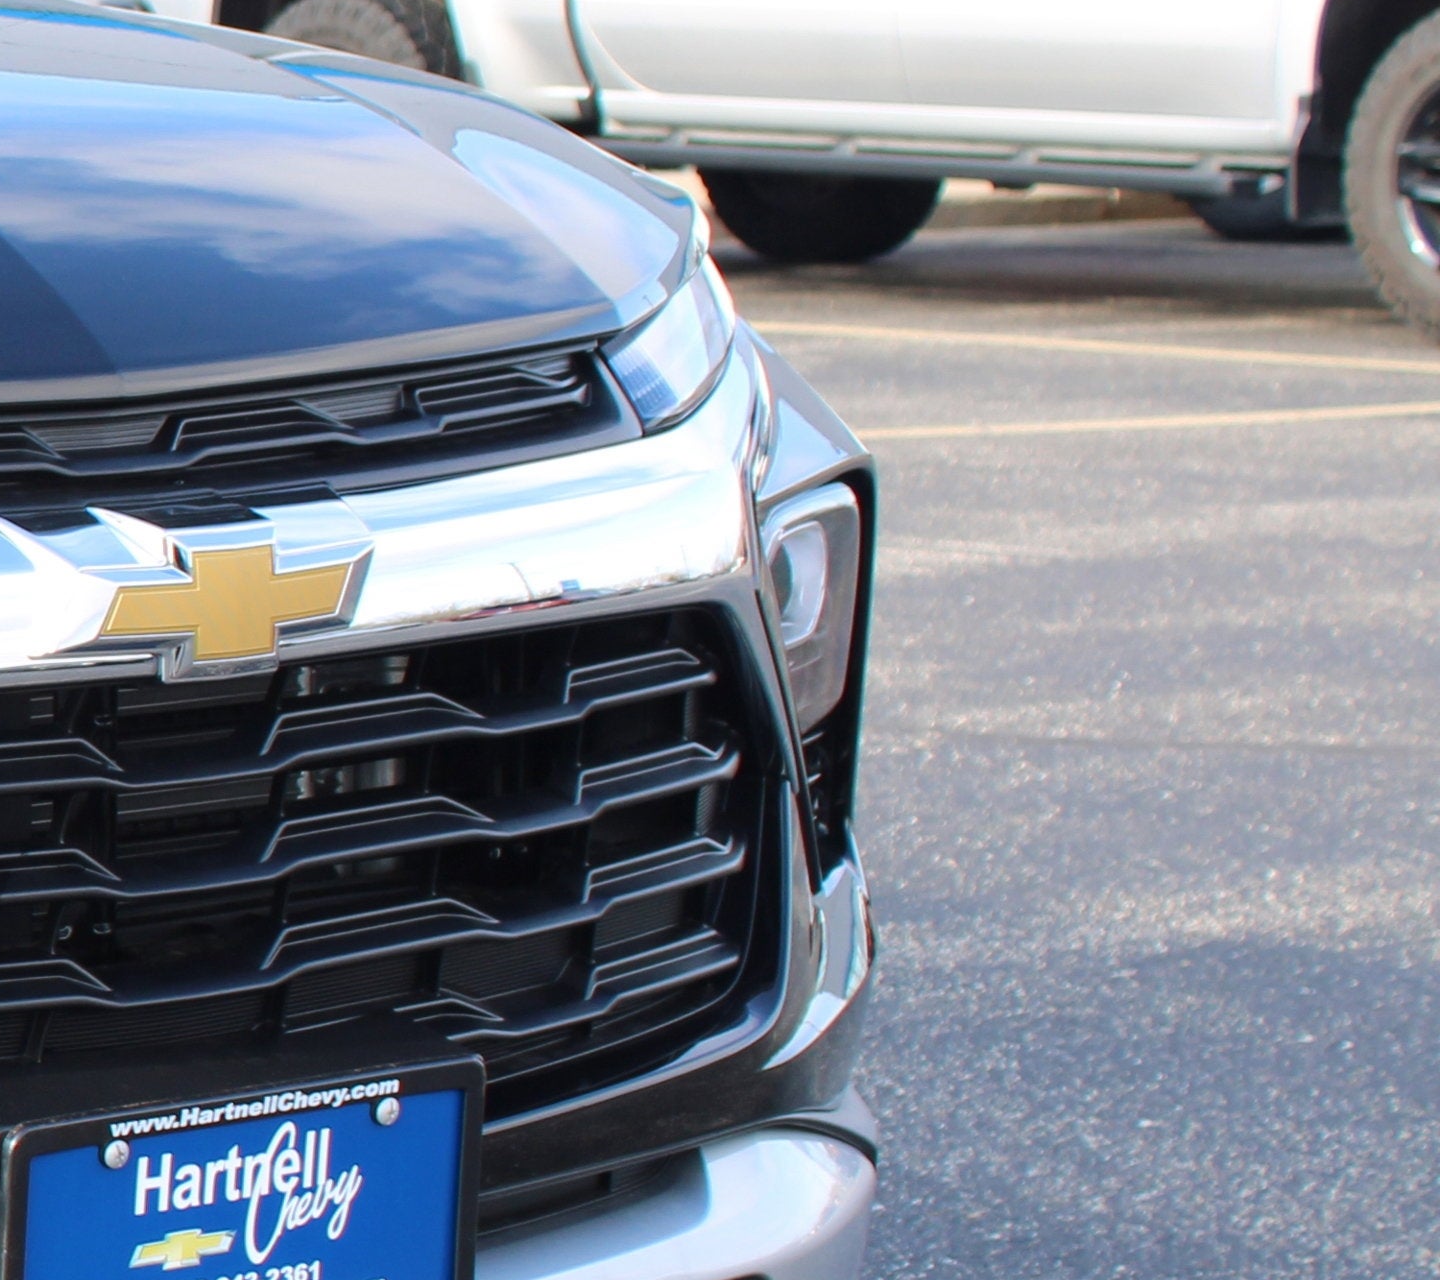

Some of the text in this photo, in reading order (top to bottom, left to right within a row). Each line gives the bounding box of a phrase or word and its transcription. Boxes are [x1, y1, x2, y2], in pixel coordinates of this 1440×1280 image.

[110, 1077, 399, 1137] www.HartnellChevy.com
[133, 1128, 332, 1215] Hartnell
[244, 1121, 363, 1264] Chevy
